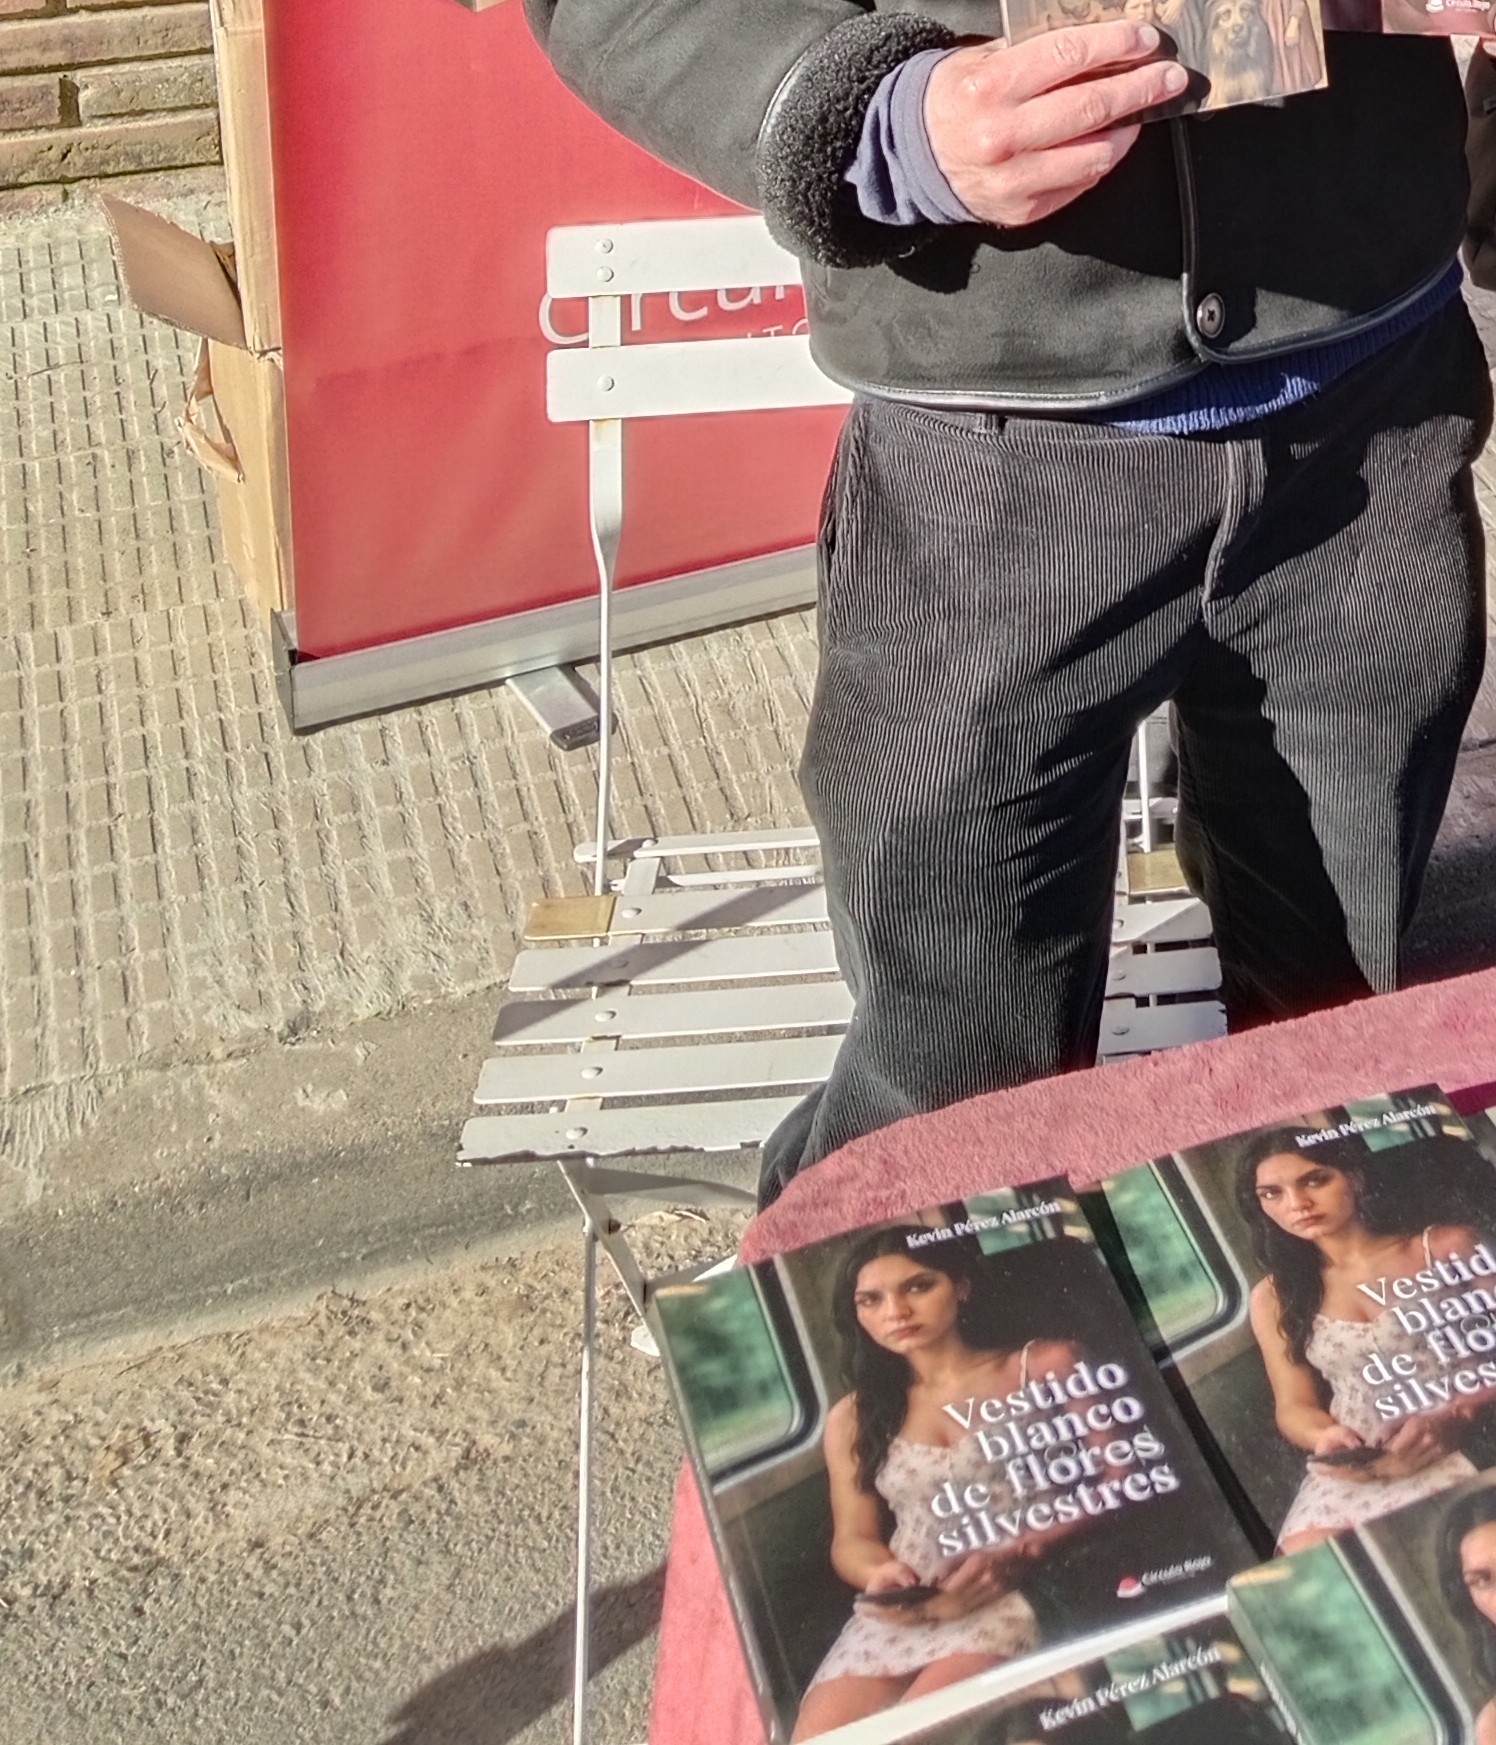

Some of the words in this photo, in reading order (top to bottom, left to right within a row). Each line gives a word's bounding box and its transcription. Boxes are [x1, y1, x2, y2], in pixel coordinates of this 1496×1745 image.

[1295, 1128, 1339, 1148] Kevin
[1382, 1104, 1438, 1125] Alarcón
[906, 1227, 953, 1249] Kevin
[954, 1216, 999, 1236] Pérez
[1001, 1201, 1062, 1225] Alarcón
[942, 1361, 1128, 1430] Vestido
[1362, 1353, 1417, 1385] de
[975, 1396, 1145, 1463] blanco
[931, 1482, 991, 1518] de
[1006, 1428, 1165, 1498] flores
[939, 1463, 1180, 1557] silvestres
[1038, 1697, 1099, 1731] Kevin
[1095, 1673, 1150, 1707] Pérez
[1151, 1646, 1222, 1685] Alarcón
